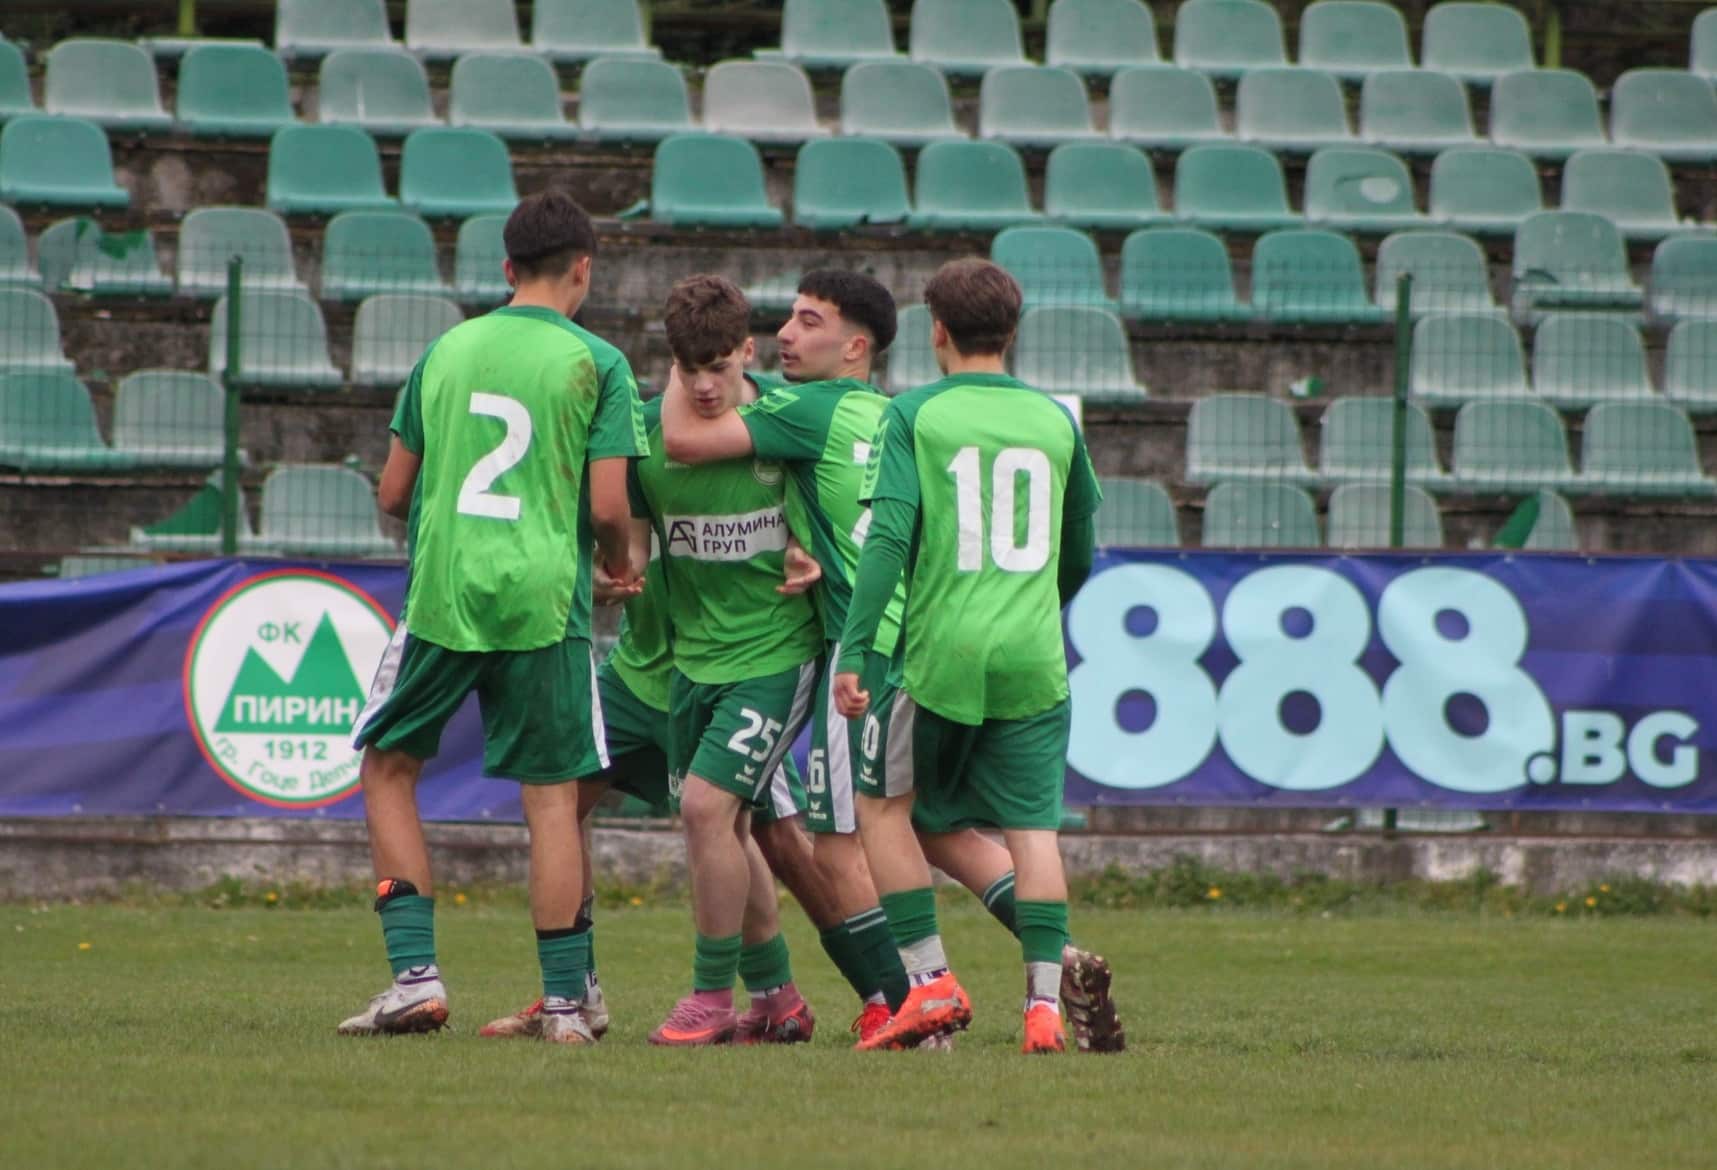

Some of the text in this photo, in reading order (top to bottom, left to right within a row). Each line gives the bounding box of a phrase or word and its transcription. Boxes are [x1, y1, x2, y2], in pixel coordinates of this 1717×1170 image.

[457, 391, 533, 521] 2
[946, 446, 1051, 573] 10
[702, 512, 785, 537] АЛУМИНА
[703, 539, 746, 554] ГРУП
[257, 620, 302, 643] ФК
[233, 694, 358, 725] ПИРИН
[727, 707, 783, 762] 25
[264, 740, 328, 760] 1912
